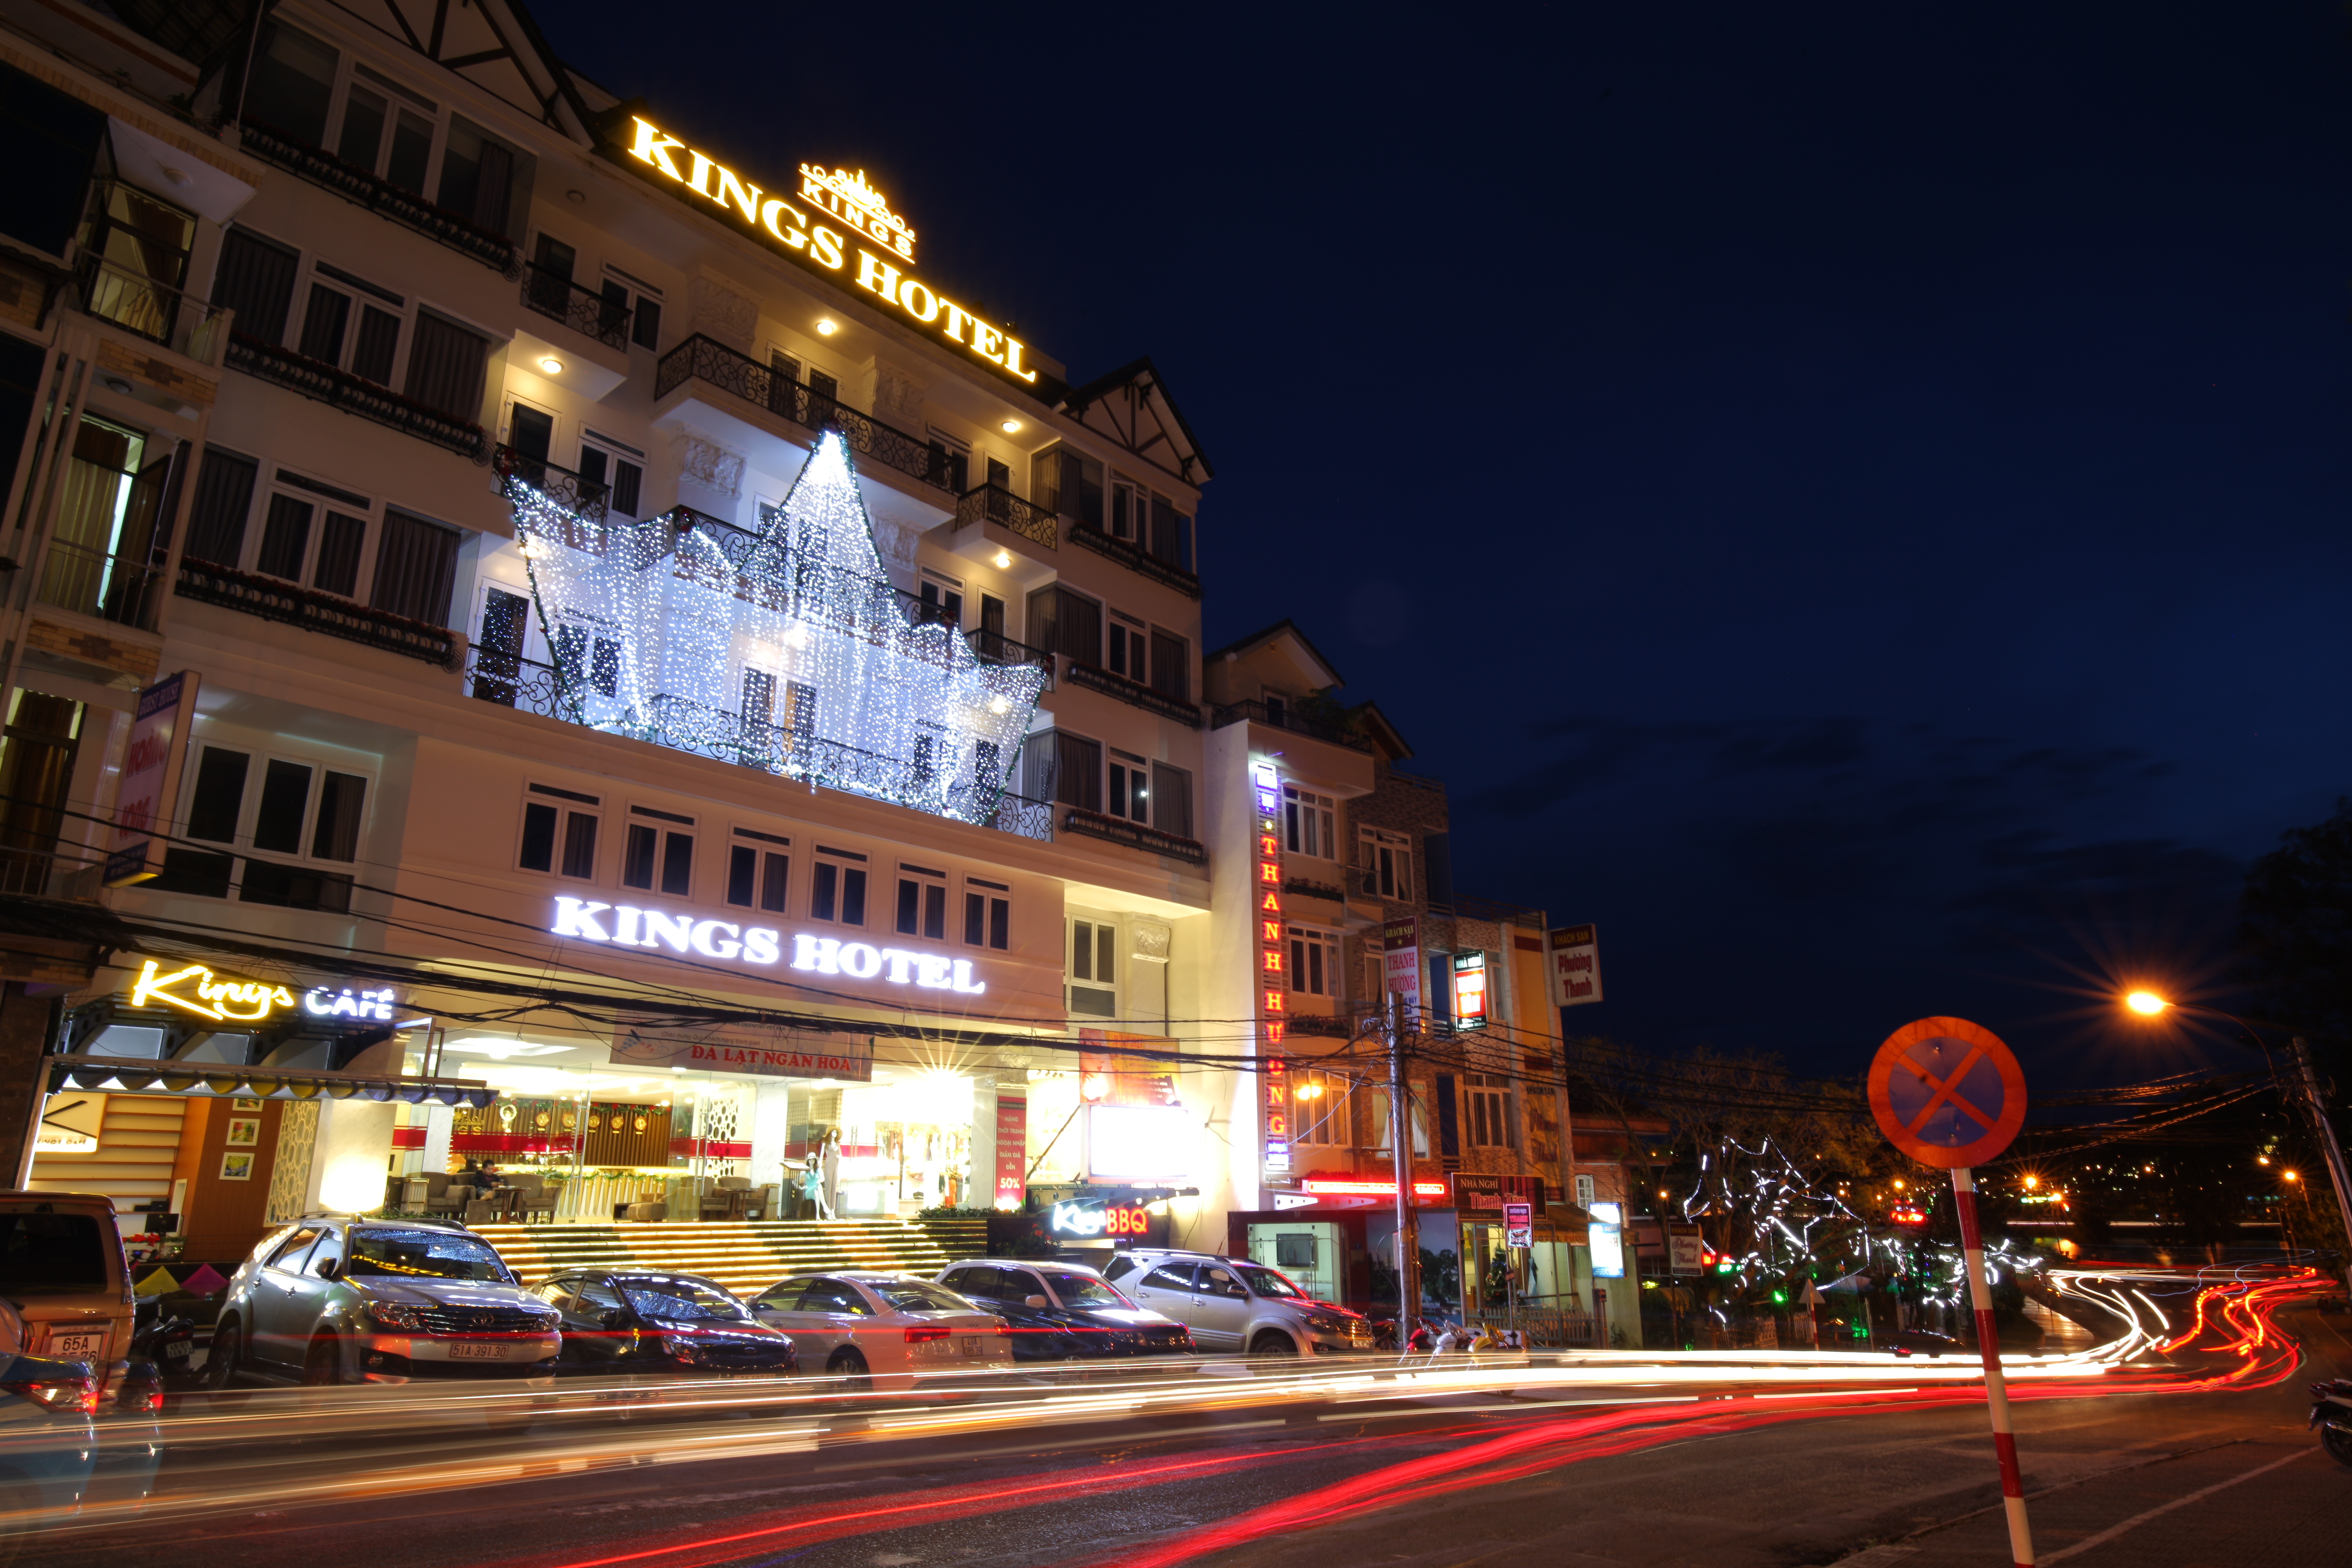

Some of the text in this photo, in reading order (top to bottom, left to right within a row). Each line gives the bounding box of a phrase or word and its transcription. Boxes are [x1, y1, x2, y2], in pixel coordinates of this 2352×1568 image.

[803, 177, 912, 256] KINGS
[628, 116, 1036, 382] KINGS HOTEL
[139, 681, 180, 716] GUEST HOUSE
[1261, 836, 1282, 971] THANH
[1385, 924, 1414, 938] KHÁCH SẠN
[1554, 930, 1589, 945] KHÁCH SẠN
[550, 896, 985, 993] KINGS HOTEL
[1387, 952, 1415, 971] THANH
[1456, 957, 1467, 969] NHÀ
[1558, 953, 1592, 974] Phương
[132, 960, 294, 1020] Kings
[1388, 973, 1416, 993] HƯƠNG
[1563, 976, 1593, 999] Thanh
[724, 1048, 760, 1065] LẠT
[817, 1056, 851, 1071] HOA
[1000, 1177, 1020, 1189] 50%
[1461, 1178, 1498, 1189] NHÀ NGHỈ
[1469, 1191, 1528, 1210] Thanh Tâm
[1106, 1208, 1148, 1233] BBQ
[63, 1337, 88, 1351] 65A
[453, 1344, 506, 1357] 51A-391.30
